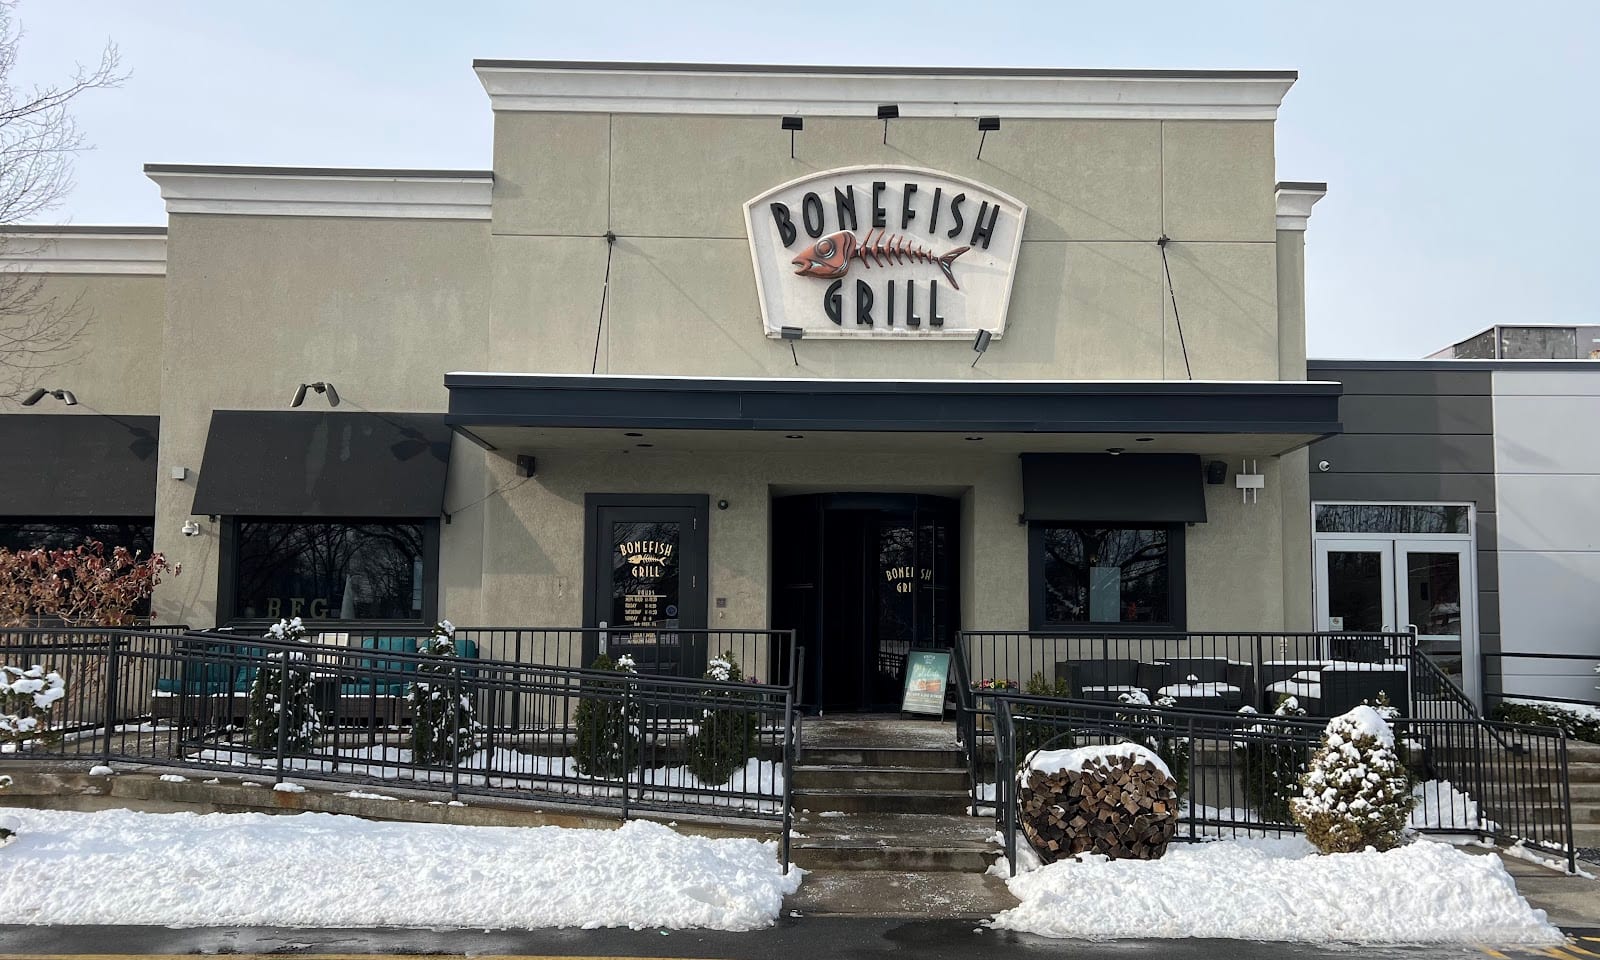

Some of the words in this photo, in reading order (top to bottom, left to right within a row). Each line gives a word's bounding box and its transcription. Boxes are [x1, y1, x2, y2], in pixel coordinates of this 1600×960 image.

[770, 181, 1000, 249] BONEFISH
[823, 279, 944, 326] GRILL
[620, 541, 673, 557] BONEFISH
[632, 566, 660, 578] GRILL
[885, 566, 932, 581] BONESH
[896, 582, 912, 593] GRI
